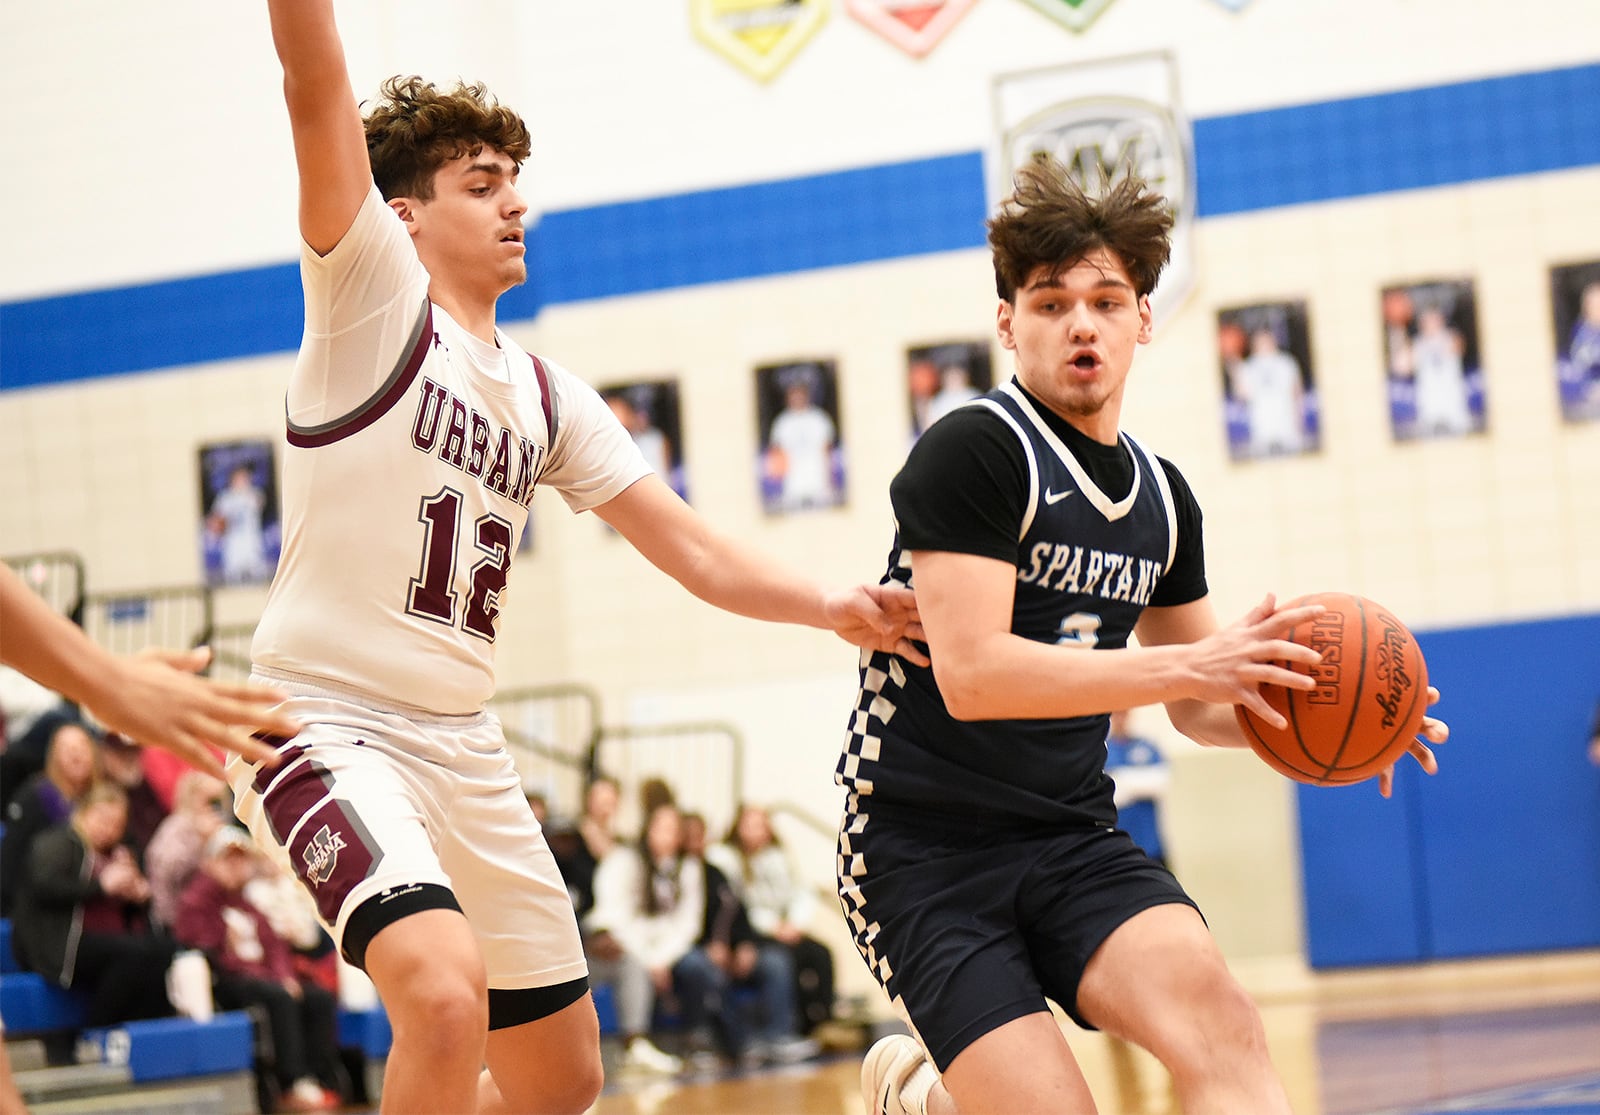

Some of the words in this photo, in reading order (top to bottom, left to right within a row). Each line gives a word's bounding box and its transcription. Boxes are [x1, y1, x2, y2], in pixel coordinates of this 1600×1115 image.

[404, 485, 513, 644] 12
[1307, 611, 1344, 705] OHSAA
[1376, 612, 1412, 729] Rawlings
